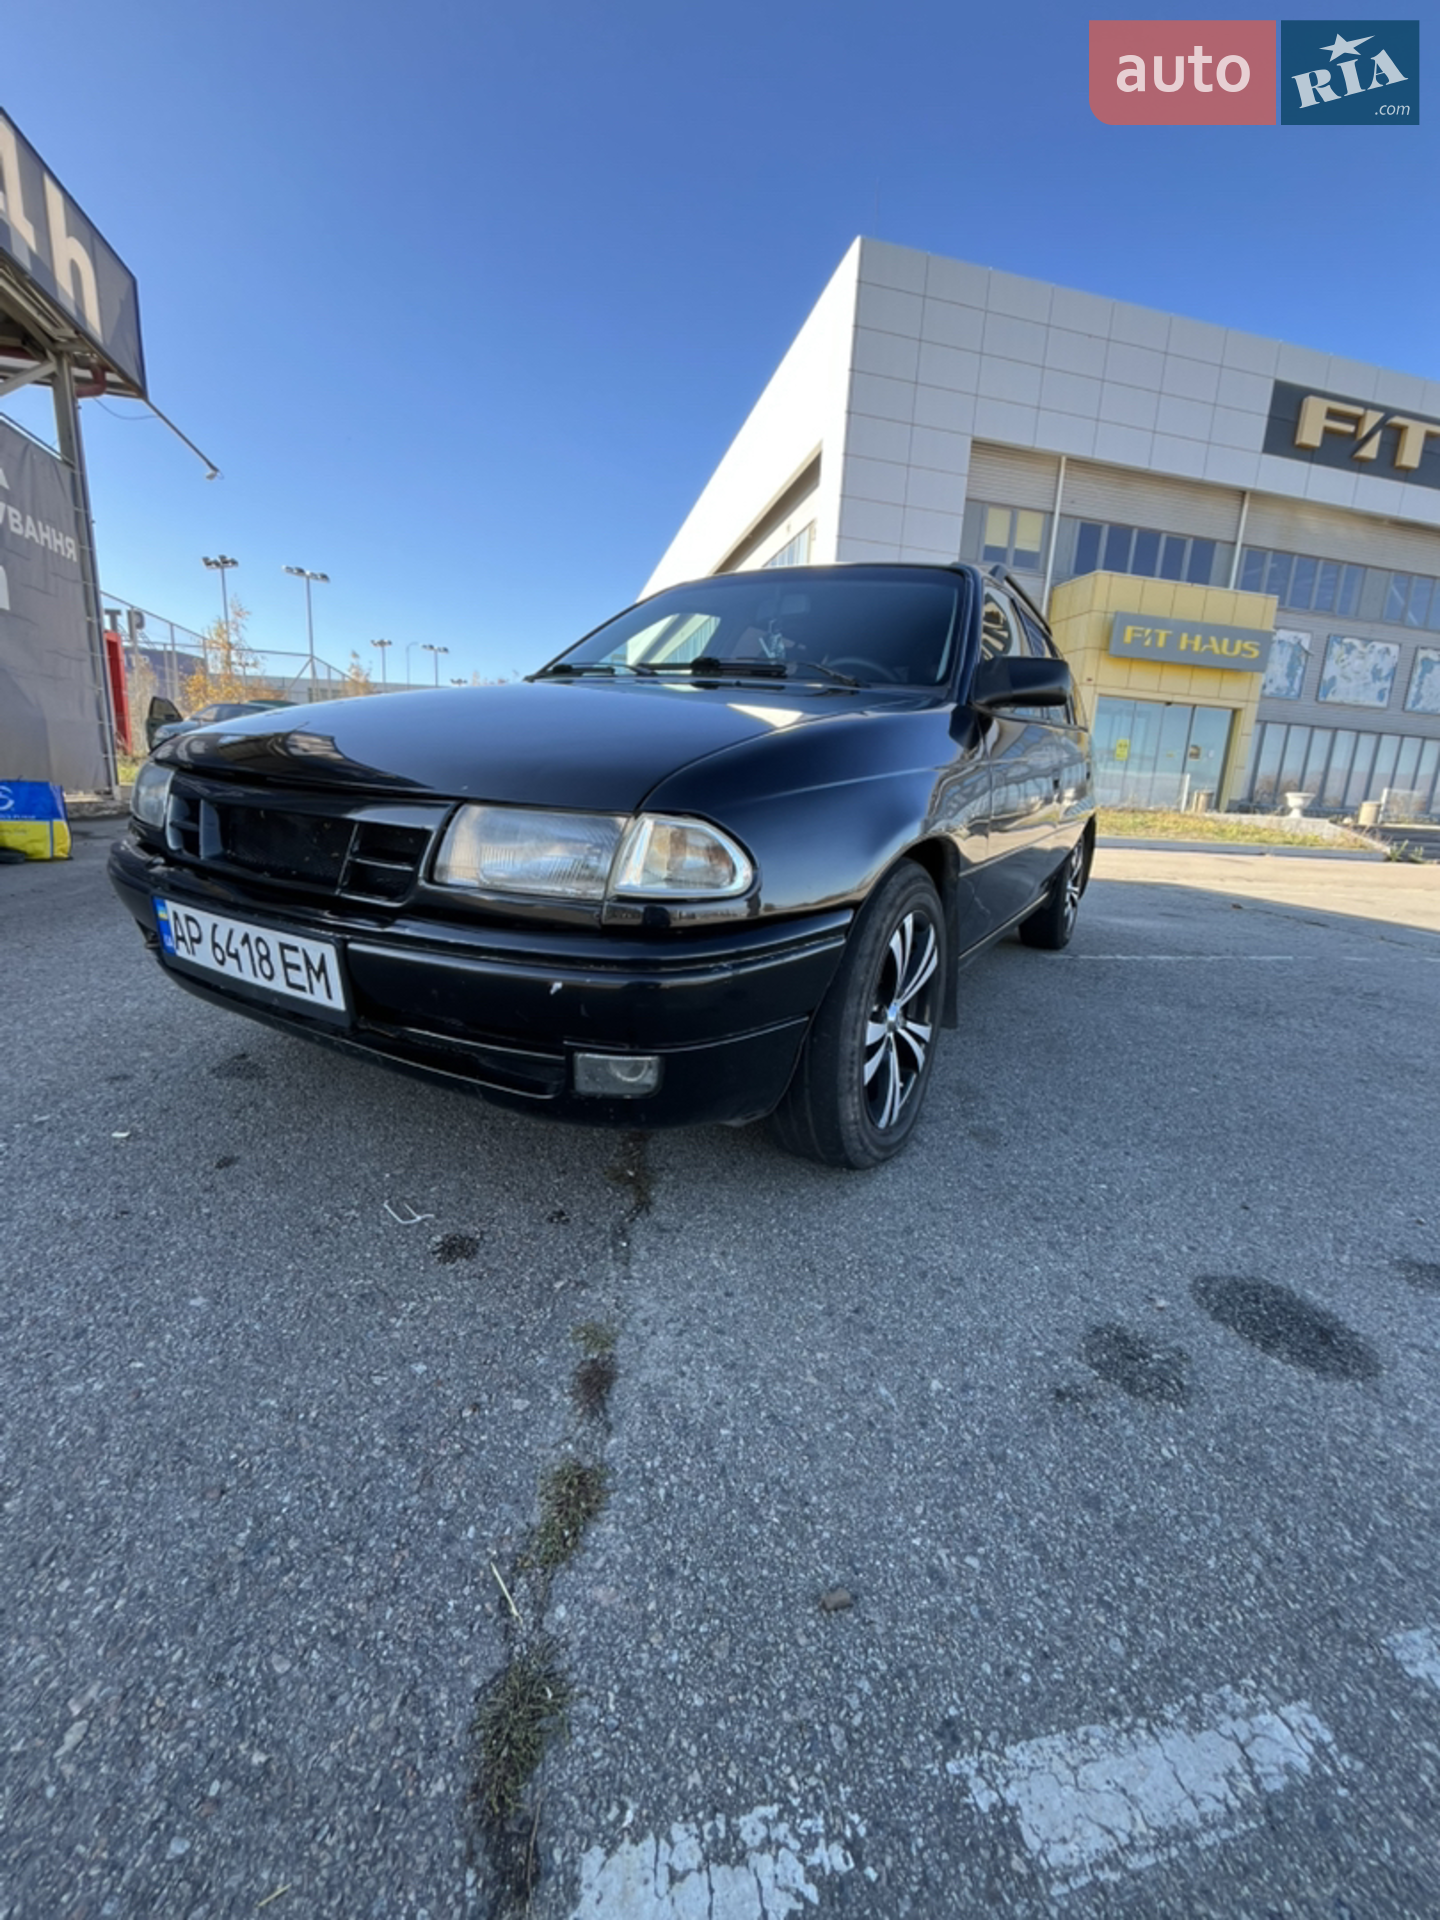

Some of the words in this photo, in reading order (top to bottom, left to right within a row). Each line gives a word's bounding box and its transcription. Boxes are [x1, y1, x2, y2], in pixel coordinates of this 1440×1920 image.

[1179, 632, 1261, 660] HAUS
[172, 909, 203, 957] AP
[210, 922, 275, 982] 6418
[278, 940, 333, 1000] EM
